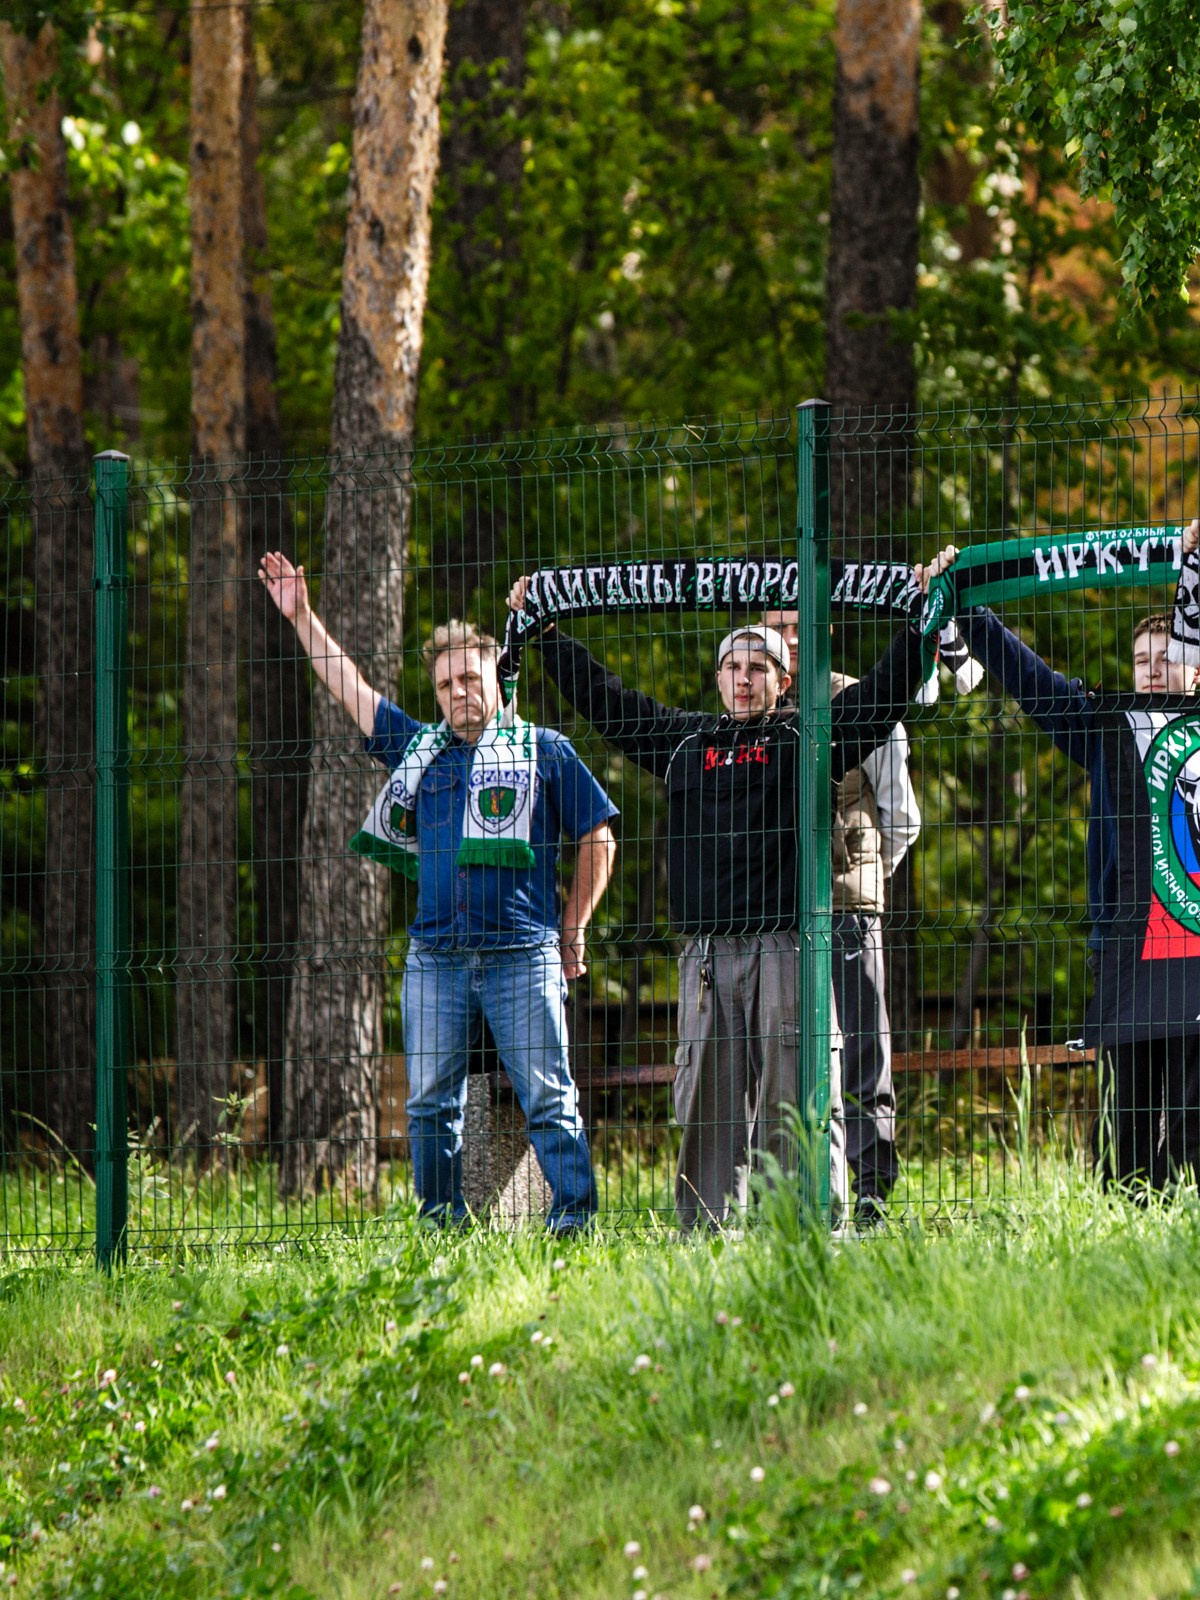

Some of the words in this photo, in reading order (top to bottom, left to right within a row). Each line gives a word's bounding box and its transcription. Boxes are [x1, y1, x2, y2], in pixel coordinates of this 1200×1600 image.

[1032, 536, 1182, 582] ИРКУТ
[697, 562, 799, 603] ВТОРО
[1151, 813, 1165, 856] КЛУБ
